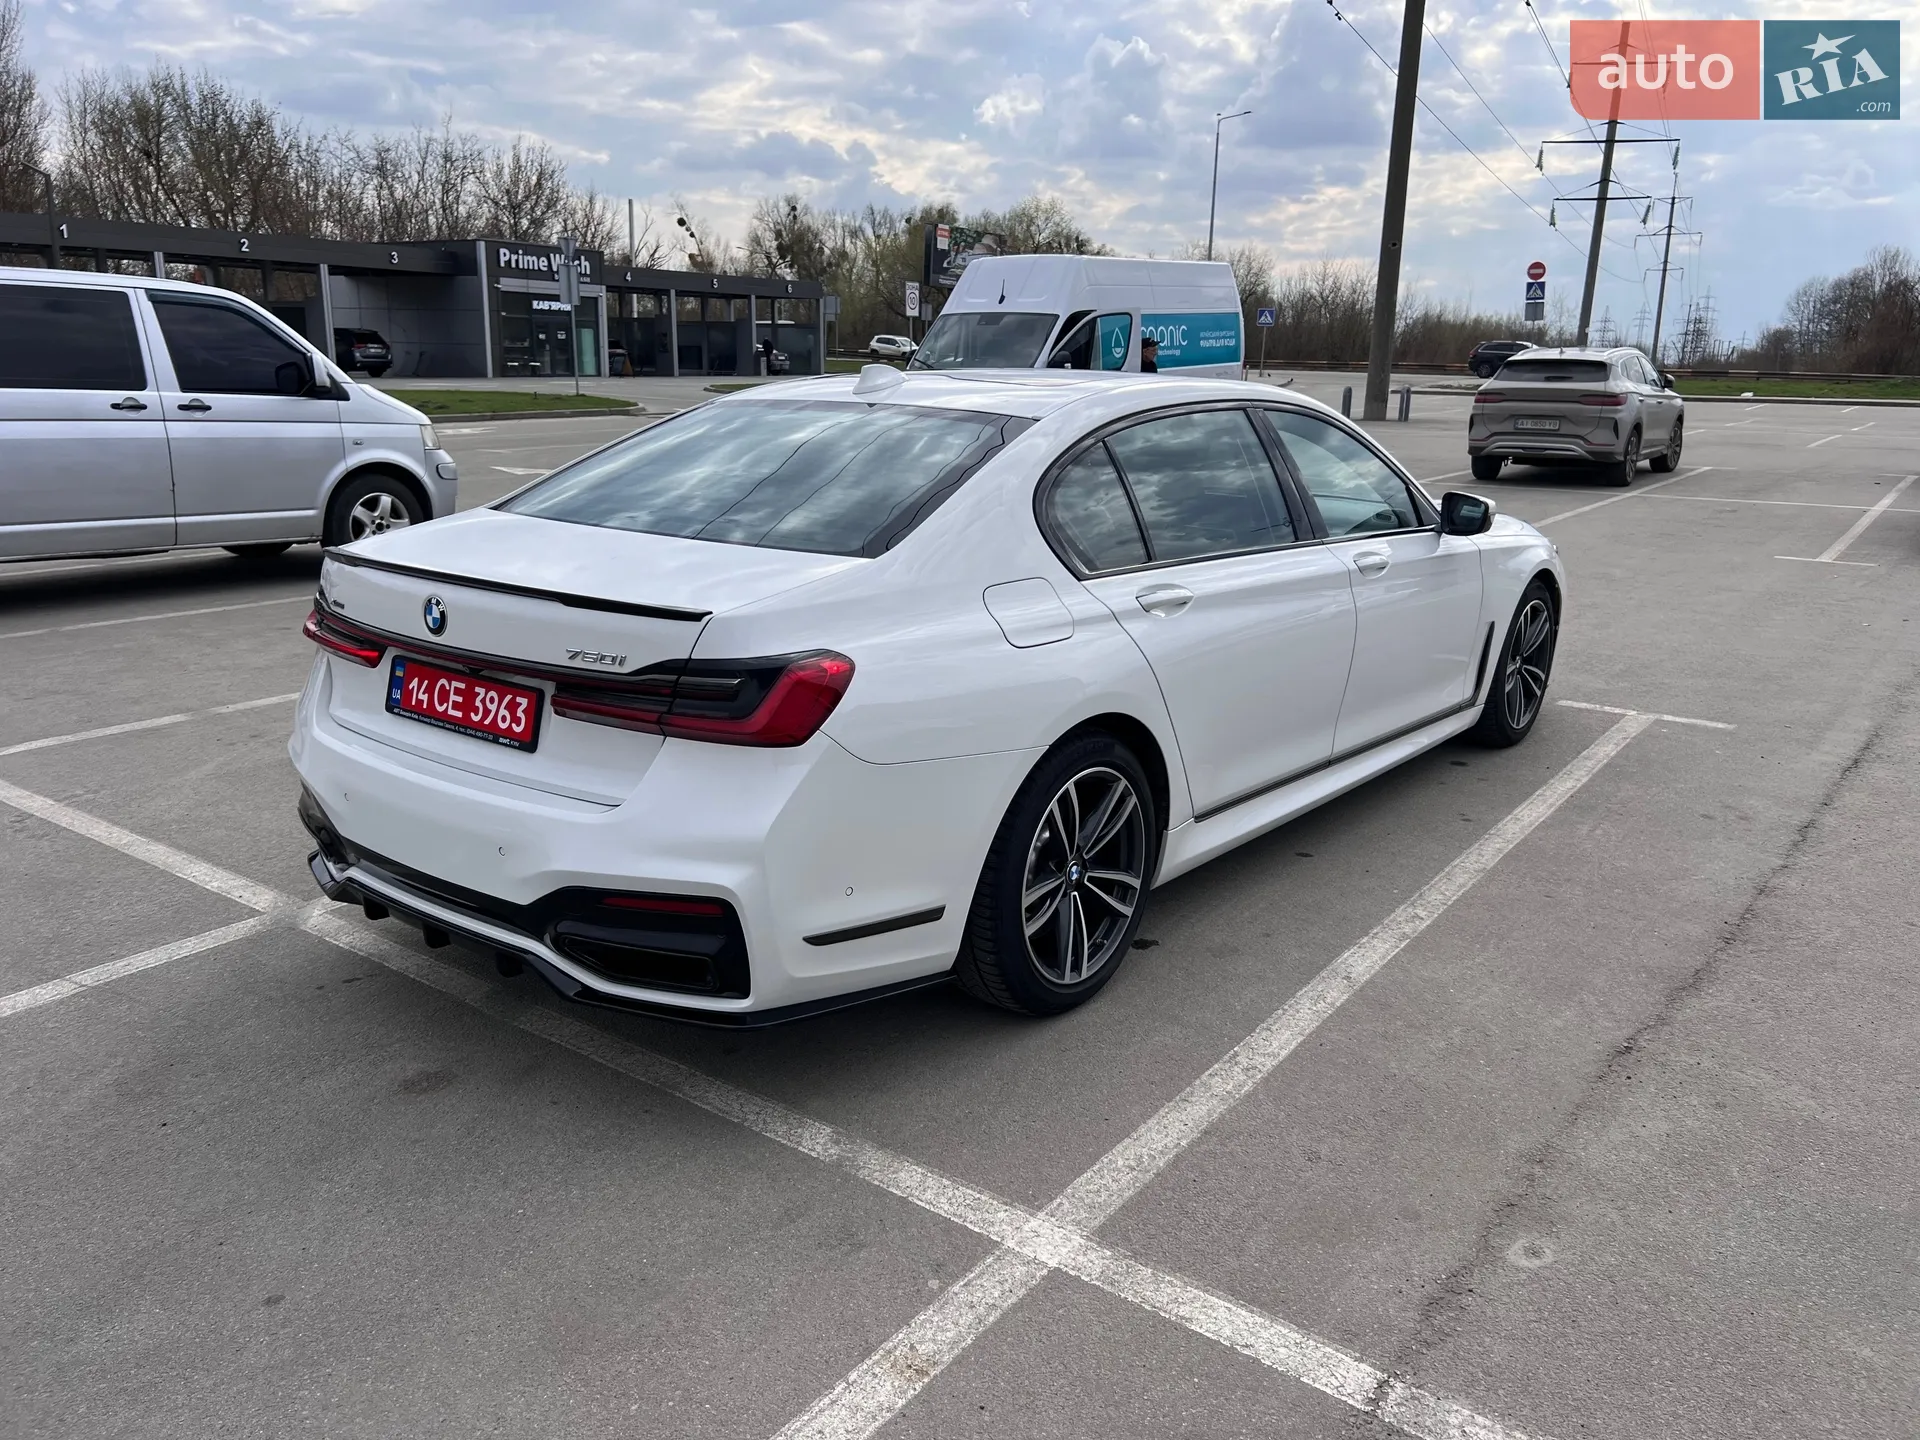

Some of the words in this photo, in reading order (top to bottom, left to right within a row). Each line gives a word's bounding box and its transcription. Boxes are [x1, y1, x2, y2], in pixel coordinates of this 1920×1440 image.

[59, 223, 68, 239] 1
[240, 238, 250, 252] 2
[389, 251, 398, 264] 3
[499, 247, 549, 271] Prime
[550, 253, 591, 275] Wsh
[625, 271, 632, 282] 4
[712, 278, 719, 288] 5
[787, 284, 793, 294] 6
[906, 283, 919, 291] ЗОНА
[909, 296, 916, 306] 10
[391, 688, 402, 700] UA
[408, 677, 429, 709] 14
[434, 678, 466, 718] CE
[470, 686, 529, 733] 3963
